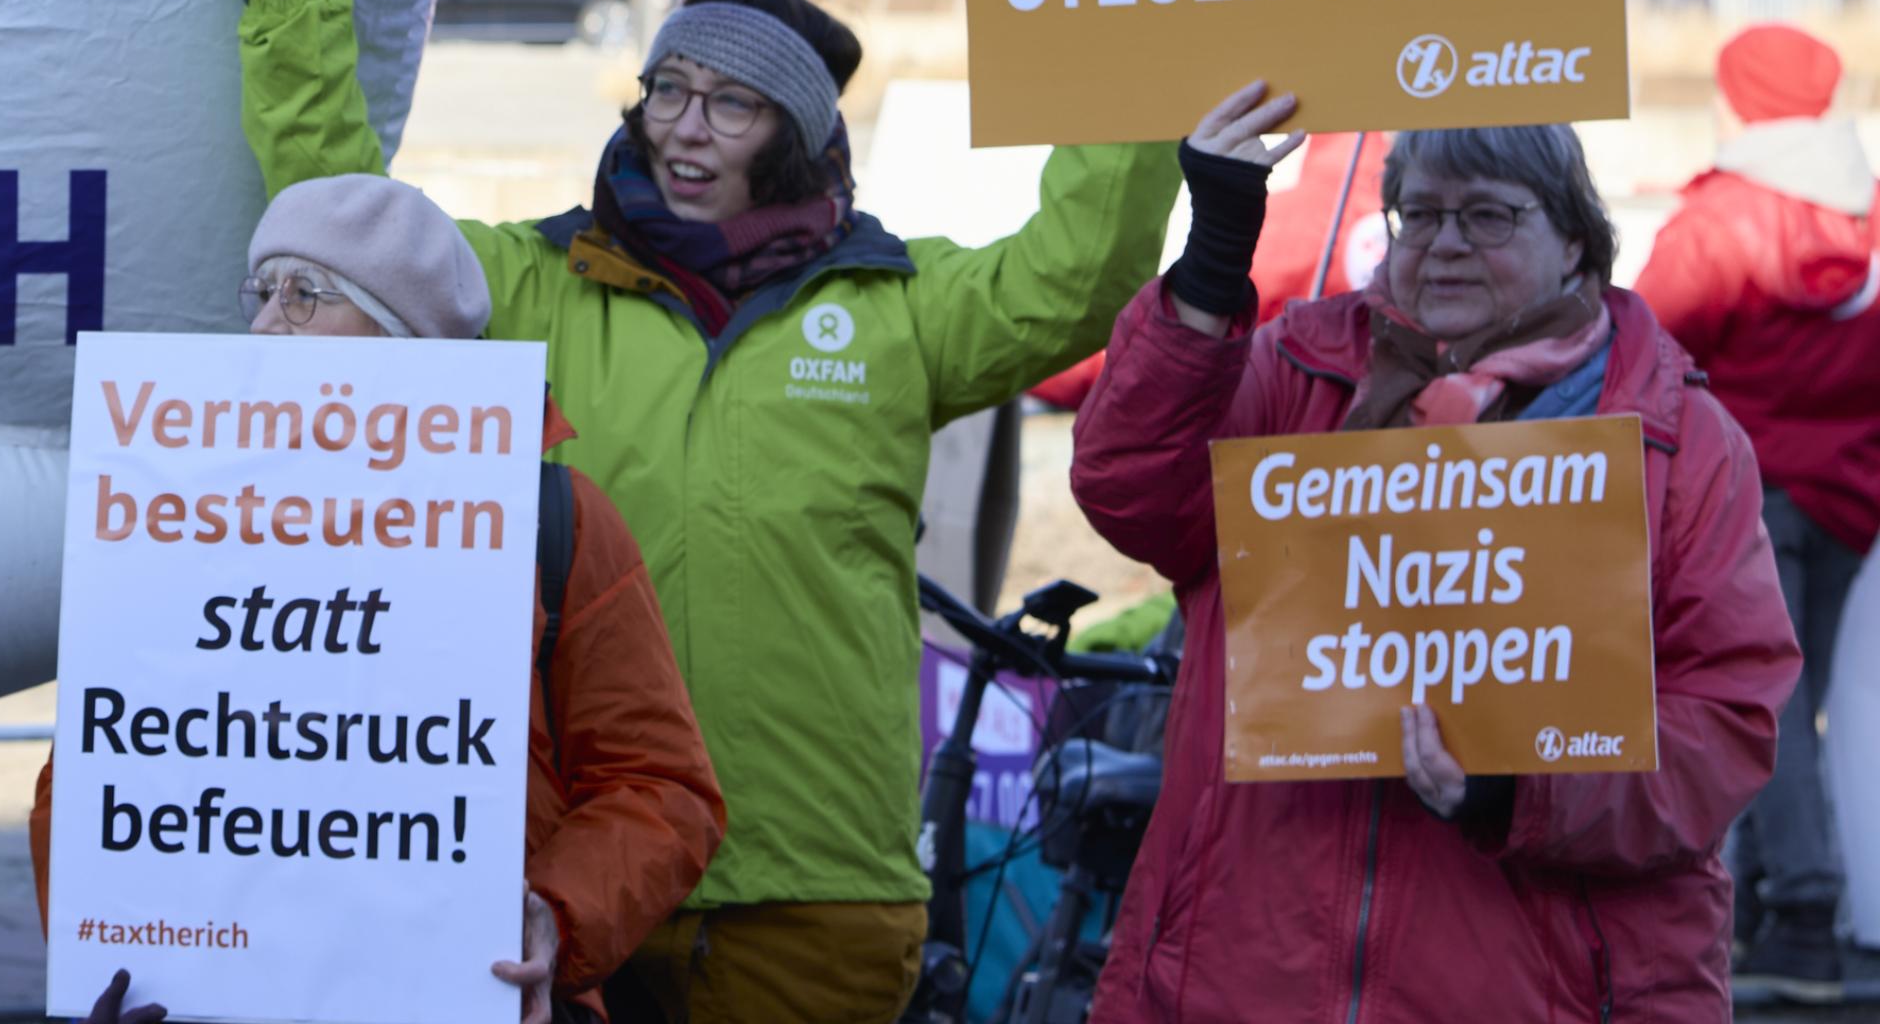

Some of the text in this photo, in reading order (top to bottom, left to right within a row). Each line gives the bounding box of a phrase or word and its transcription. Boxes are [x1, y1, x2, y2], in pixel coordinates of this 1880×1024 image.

[1465, 40, 1592, 87] attac
[784, 383, 870, 404] Deutschland
[789, 356, 867, 384] OXFAM
[100, 379, 514, 470] Vermögen
[93, 474, 505, 550] besteuern
[1249, 443, 1608, 521] Gemeinsam
[1343, 527, 1526, 609] Nazis
[195, 584, 391, 654] statt
[1301, 621, 1573, 704] stoppen
[80, 687, 497, 767] Rechtsruck
[1566, 733, 1624, 757] attac
[100, 784, 468, 864] befeuern!
[77, 917, 250, 950] #taxtherich
